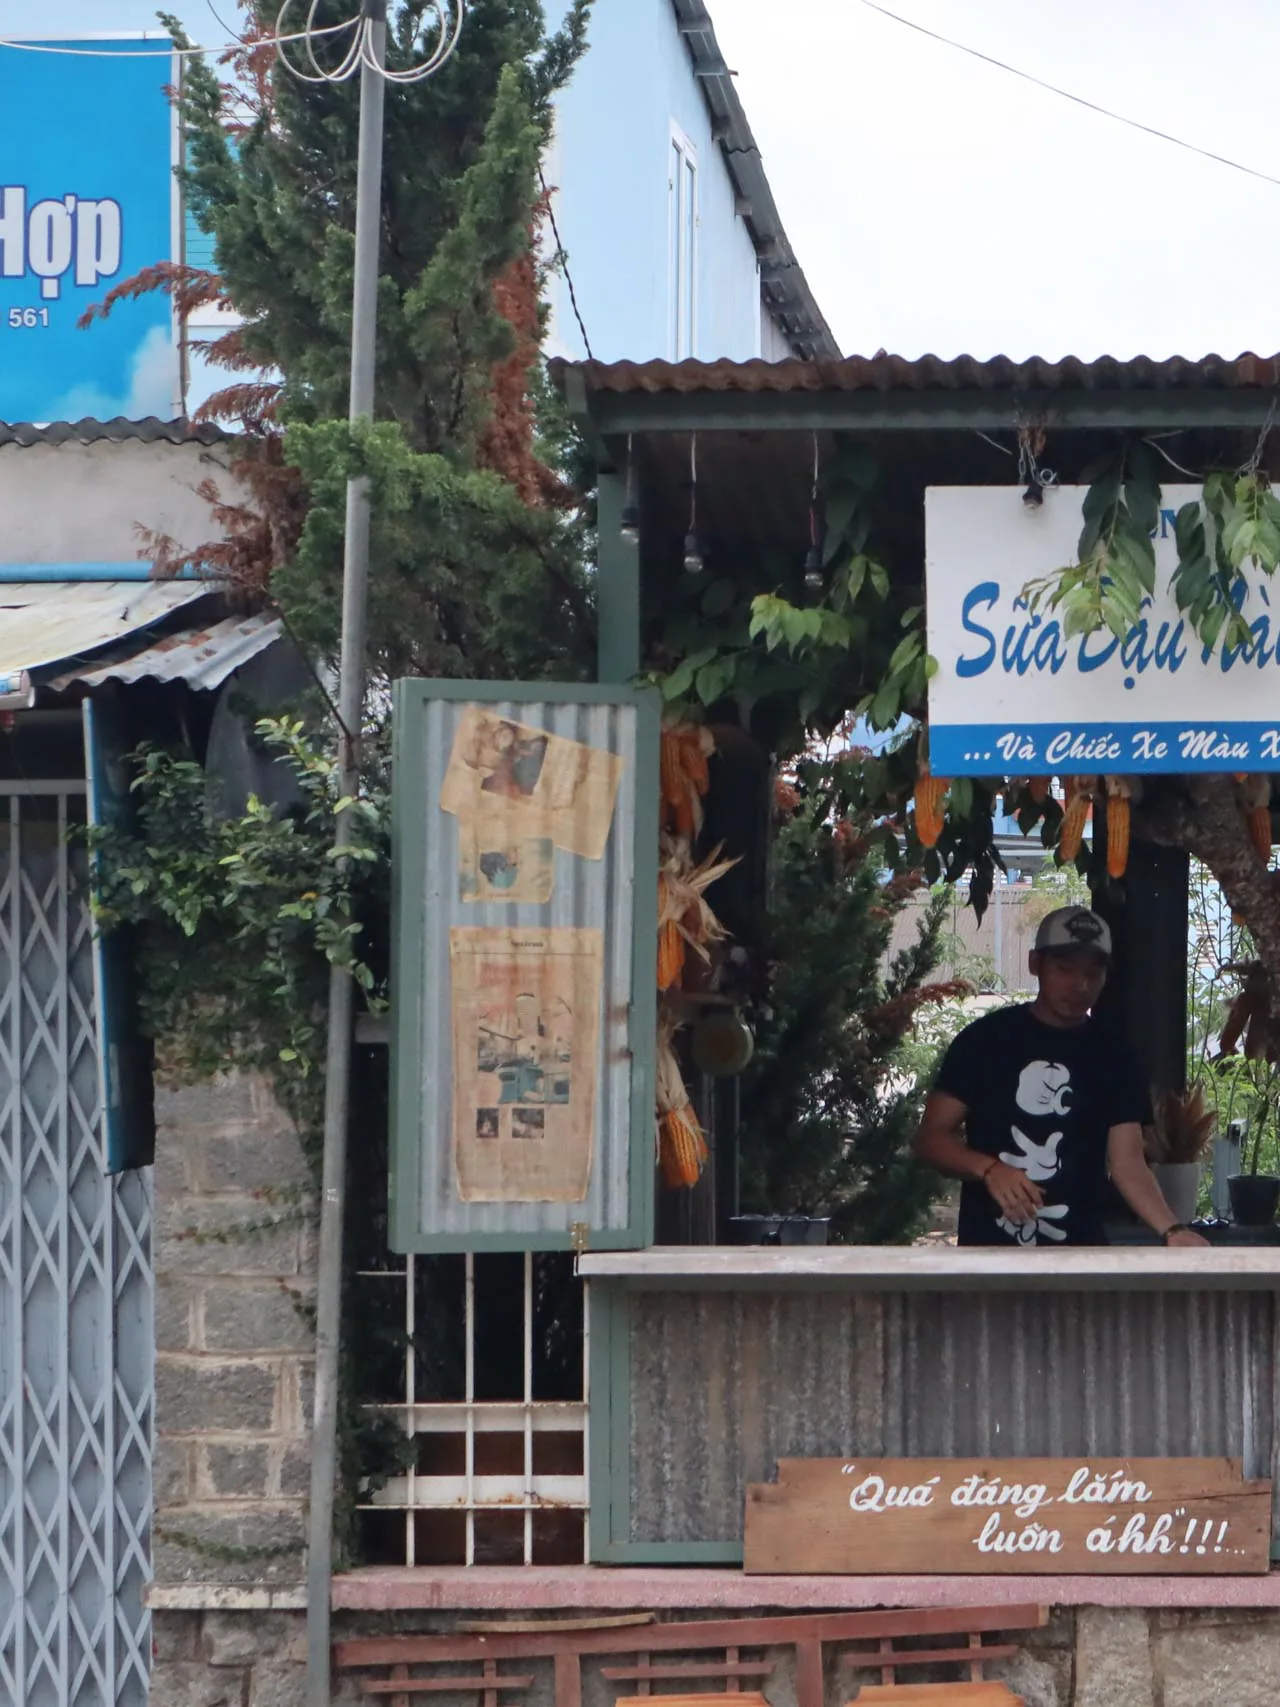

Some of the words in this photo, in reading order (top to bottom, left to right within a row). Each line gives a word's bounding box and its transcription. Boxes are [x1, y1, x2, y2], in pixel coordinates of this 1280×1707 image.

[9, 307, 48, 328] 561
[1045, 731, 1121, 764] Chiếc
[1131, 730, 1168, 760] Xe
[1178, 730, 1250, 760] Màu
[950, 1474, 1053, 1518] đáng
[1057, 1467, 1153, 1503] lắm
